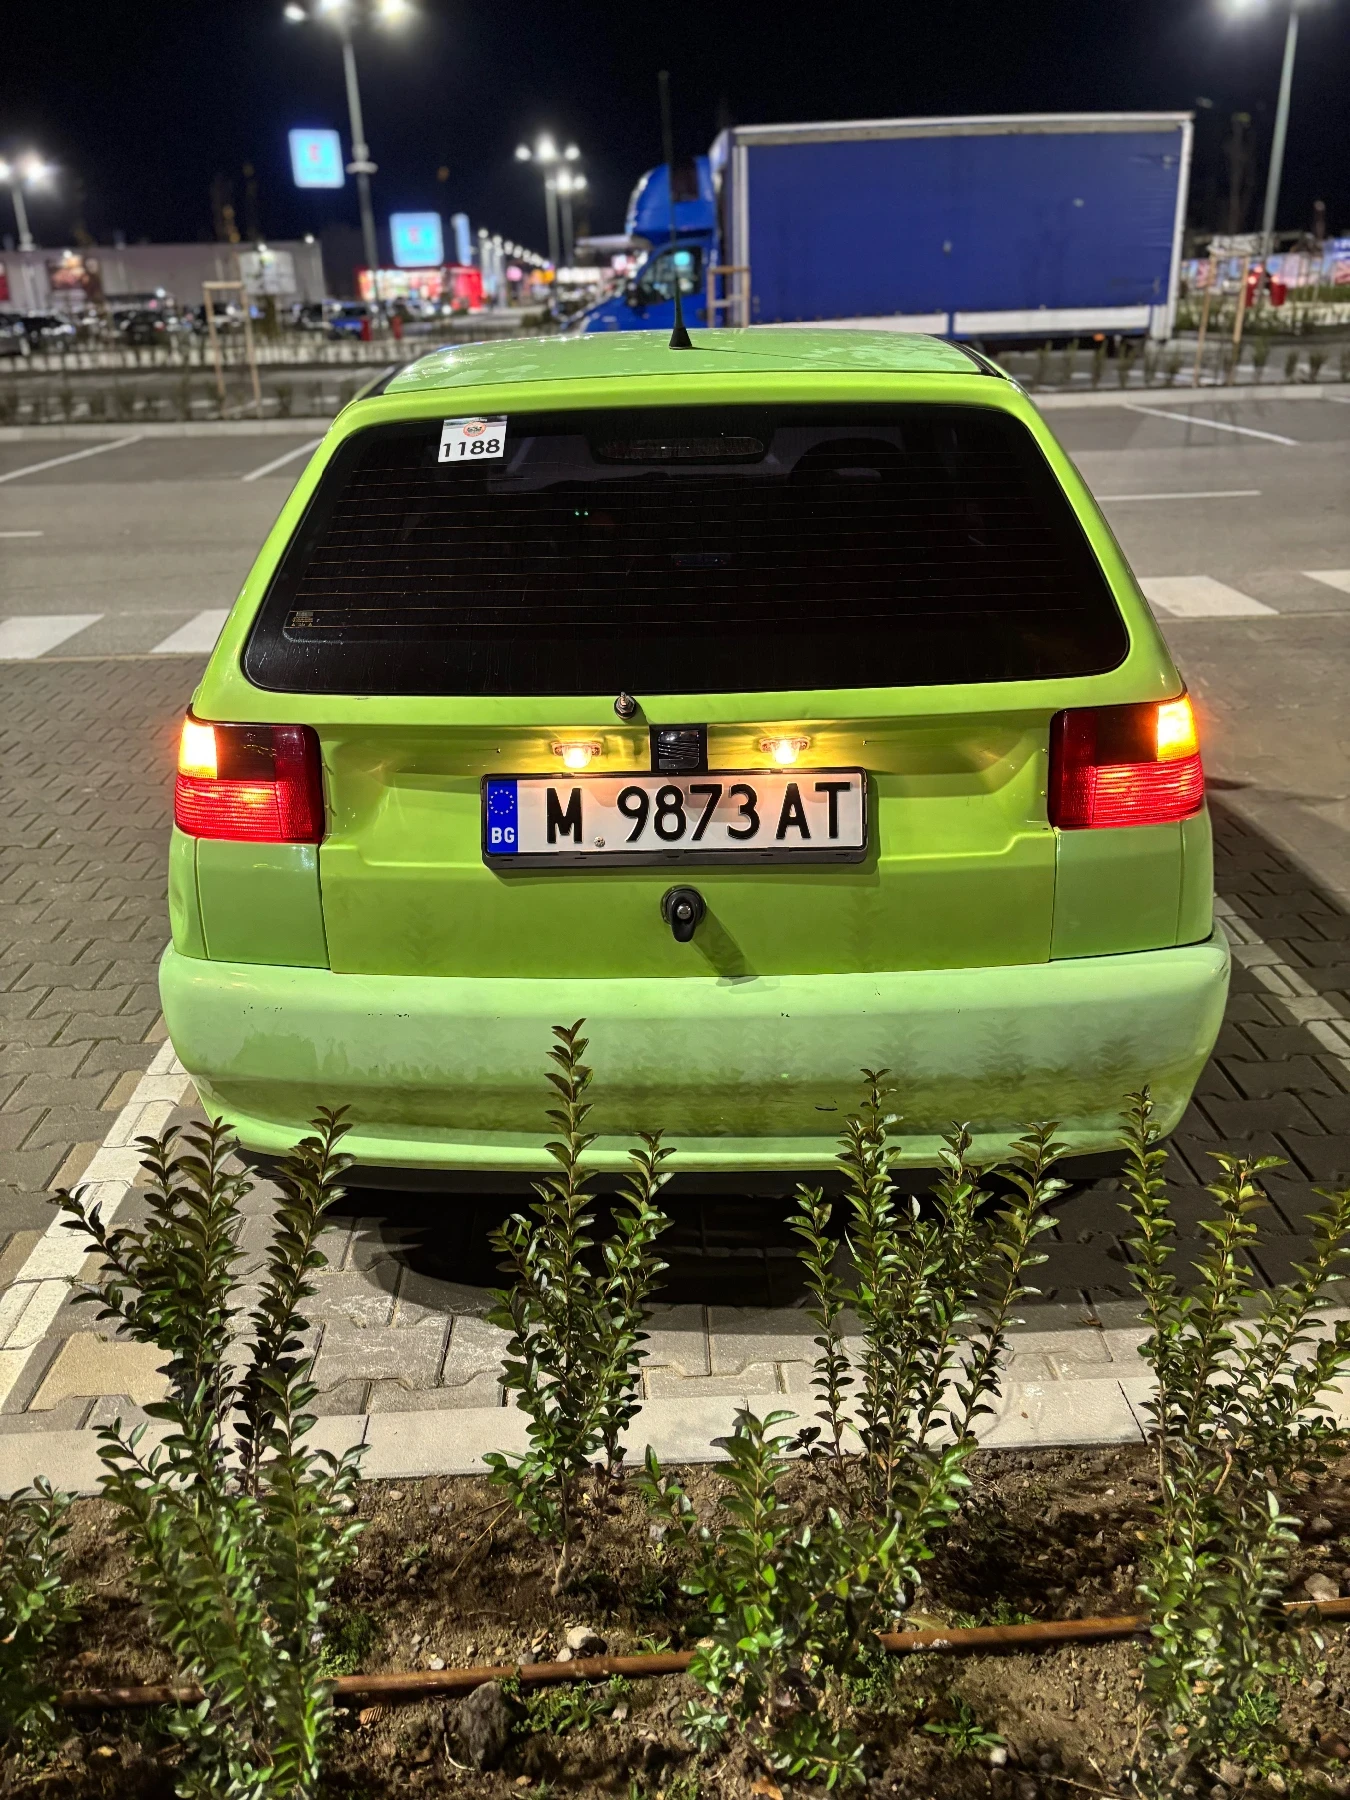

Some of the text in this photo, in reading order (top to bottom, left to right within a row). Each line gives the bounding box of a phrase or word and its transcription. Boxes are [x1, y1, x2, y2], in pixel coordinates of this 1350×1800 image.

[443, 438, 500, 457] 1188
[546, 782, 851, 844] M 9873 AT
[491, 827, 515, 843] BG
